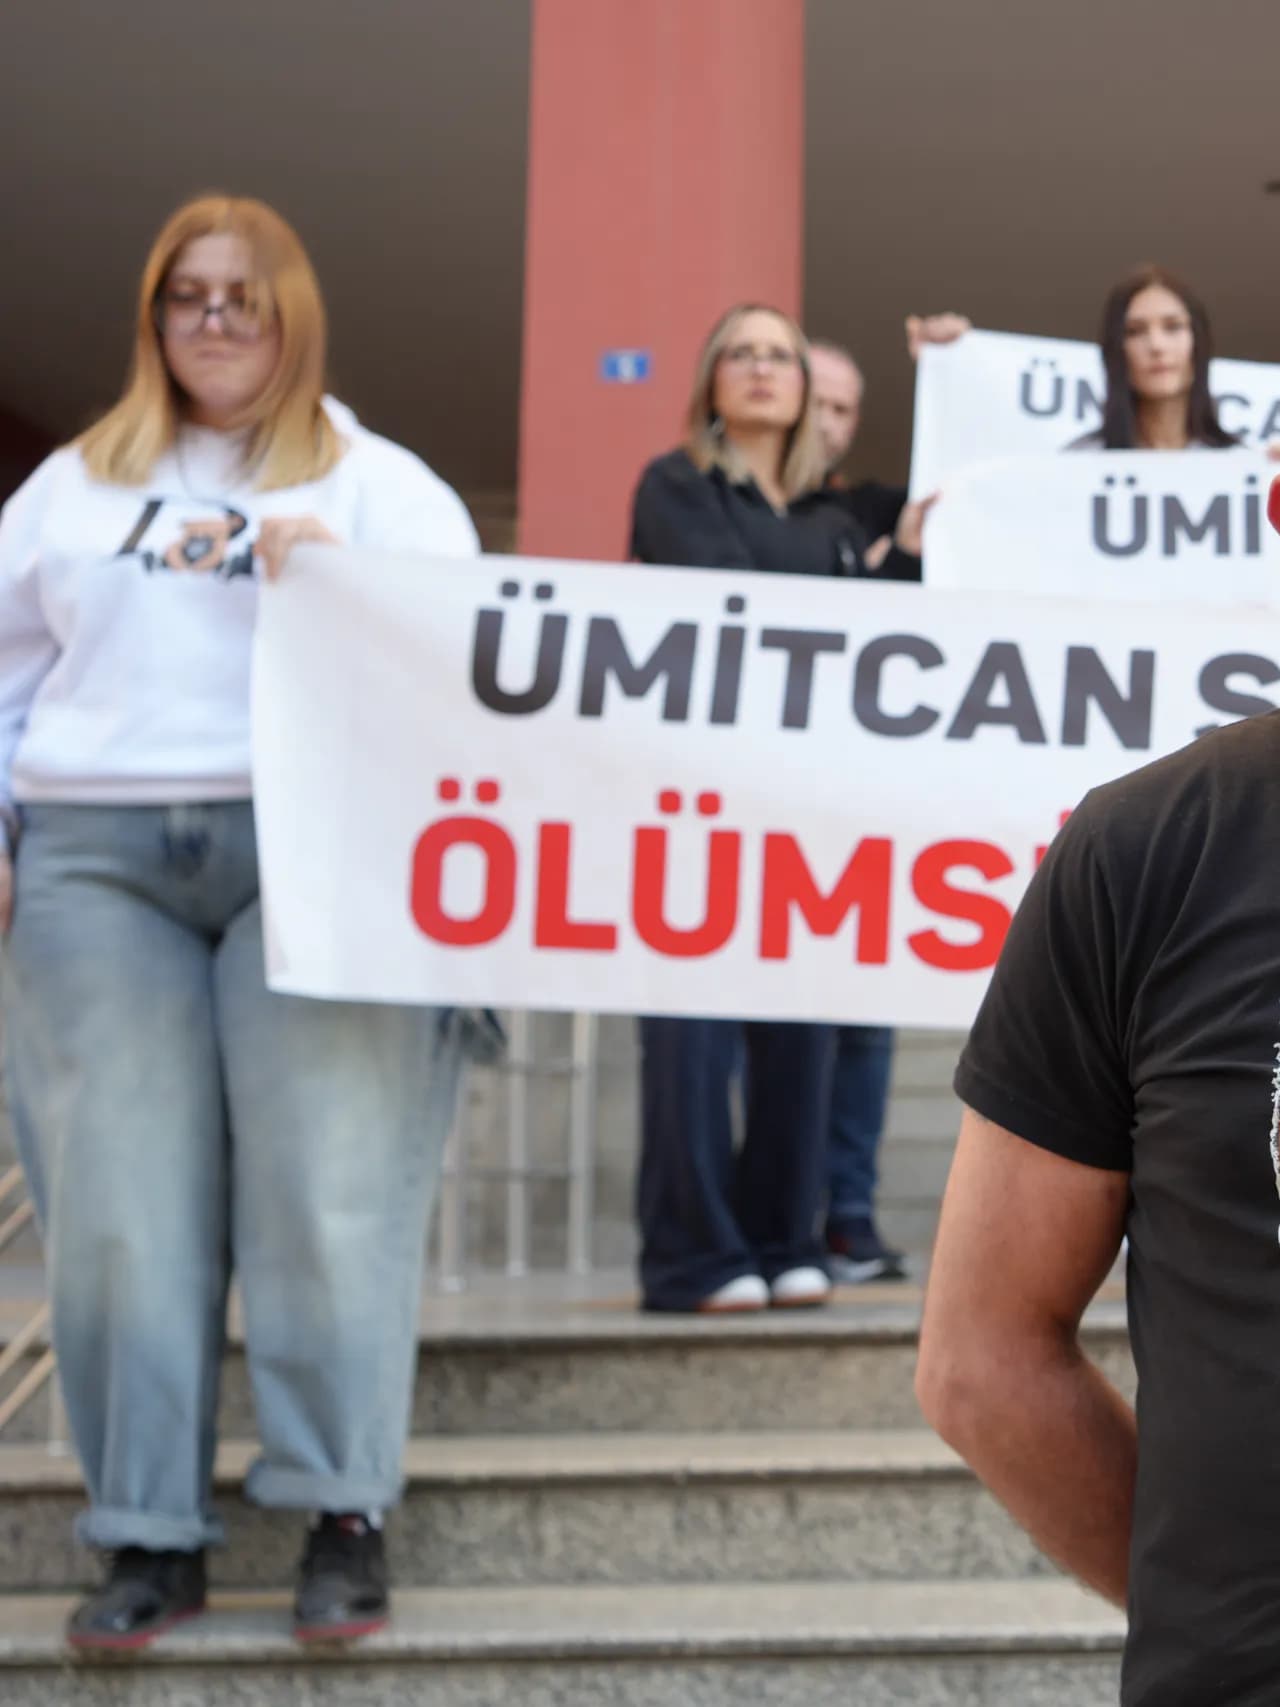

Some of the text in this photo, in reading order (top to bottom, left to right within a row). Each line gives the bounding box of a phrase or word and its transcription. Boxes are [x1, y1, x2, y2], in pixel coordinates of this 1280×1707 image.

[1092, 475, 1261, 557] ÜMİ
[469, 580, 1157, 751] ÜMİTCAN
[409, 776, 1073, 973] ÖLÜMS
